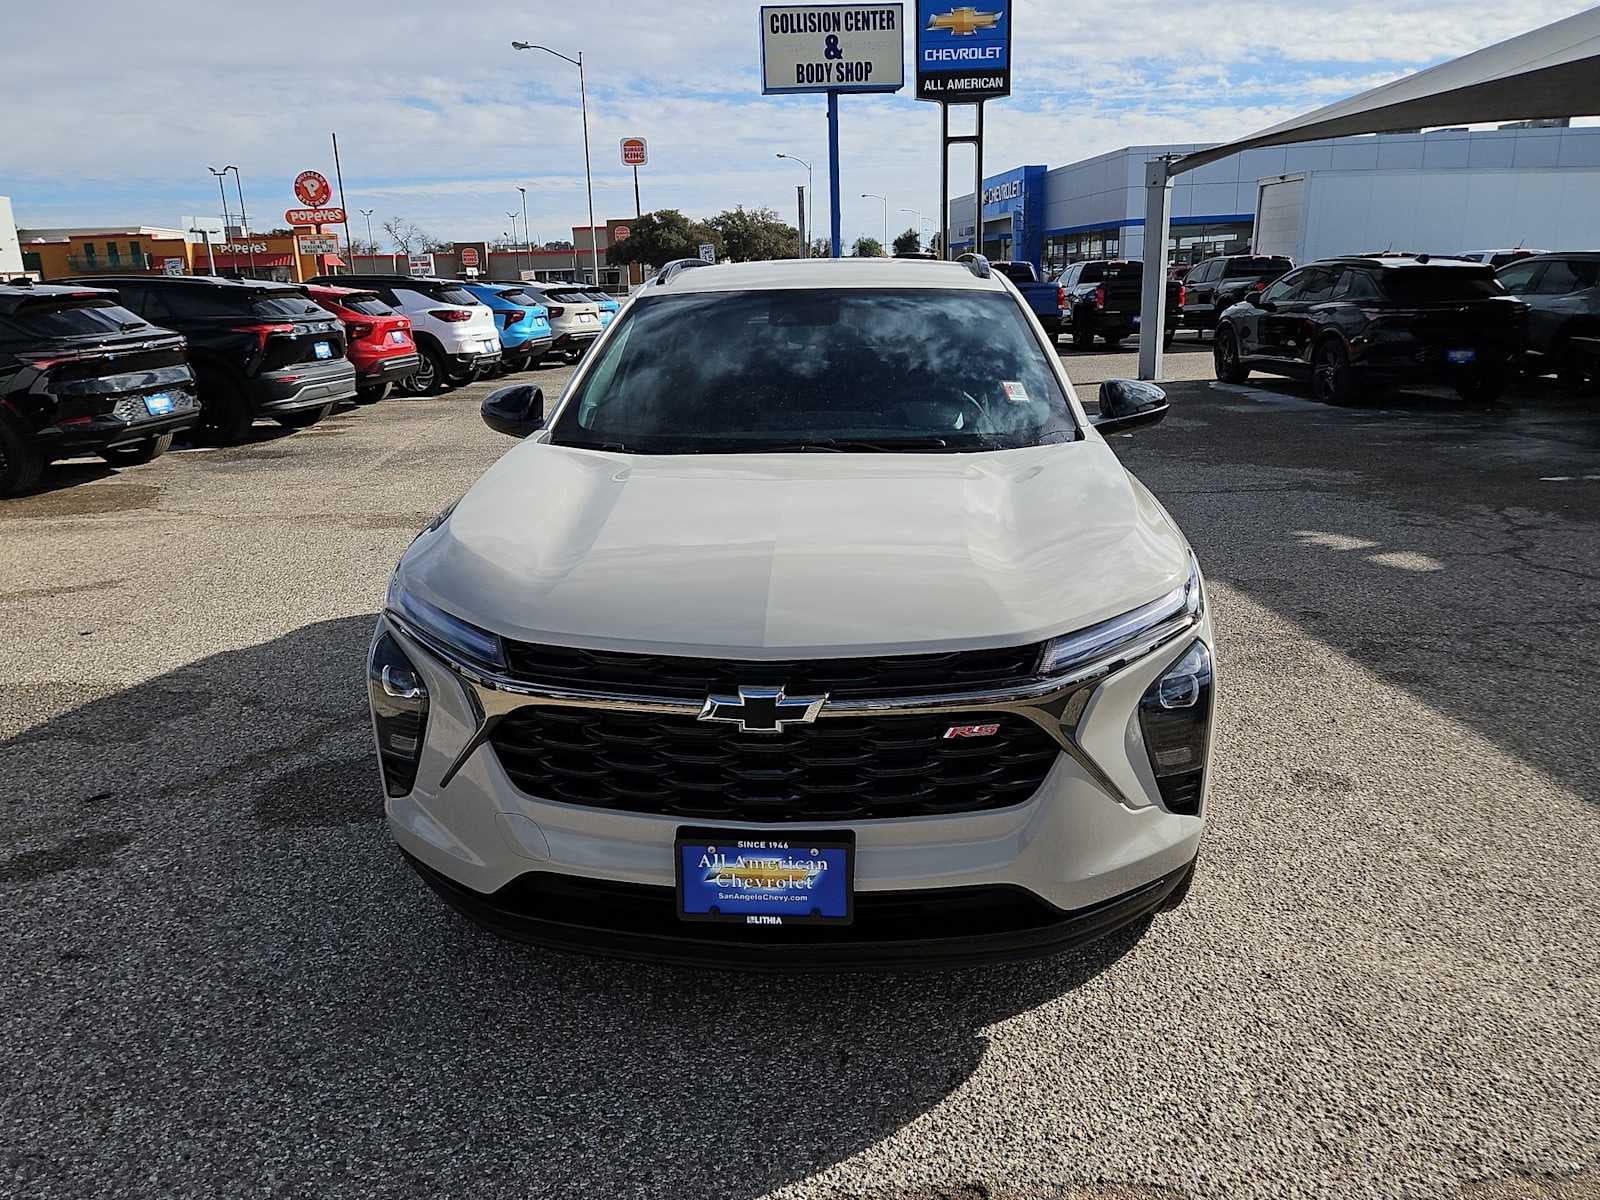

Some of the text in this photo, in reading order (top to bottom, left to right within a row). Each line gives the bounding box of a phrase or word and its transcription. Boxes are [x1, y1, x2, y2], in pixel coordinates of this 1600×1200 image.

[770, 10, 895, 34] COLLISION CENTER
[824, 34, 843, 60] &
[924, 46, 1003, 61] CHEVROLET
[796, 61, 873, 84] BODY SHOP
[924, 77, 1004, 91] ALL AMERICAN
[624, 152, 645, 160] KING
[988, 180, 1022, 204] CHEVROLET
[943, 723, 1000, 739] RS
[737, 840, 789, 849] SINCE 1946
[698, 853, 828, 871] All American
[716, 873, 814, 890] Chevrolet
[718, 892, 808, 902] SanAngeloChevy.com
[755, 916, 782, 925] LITHIA
